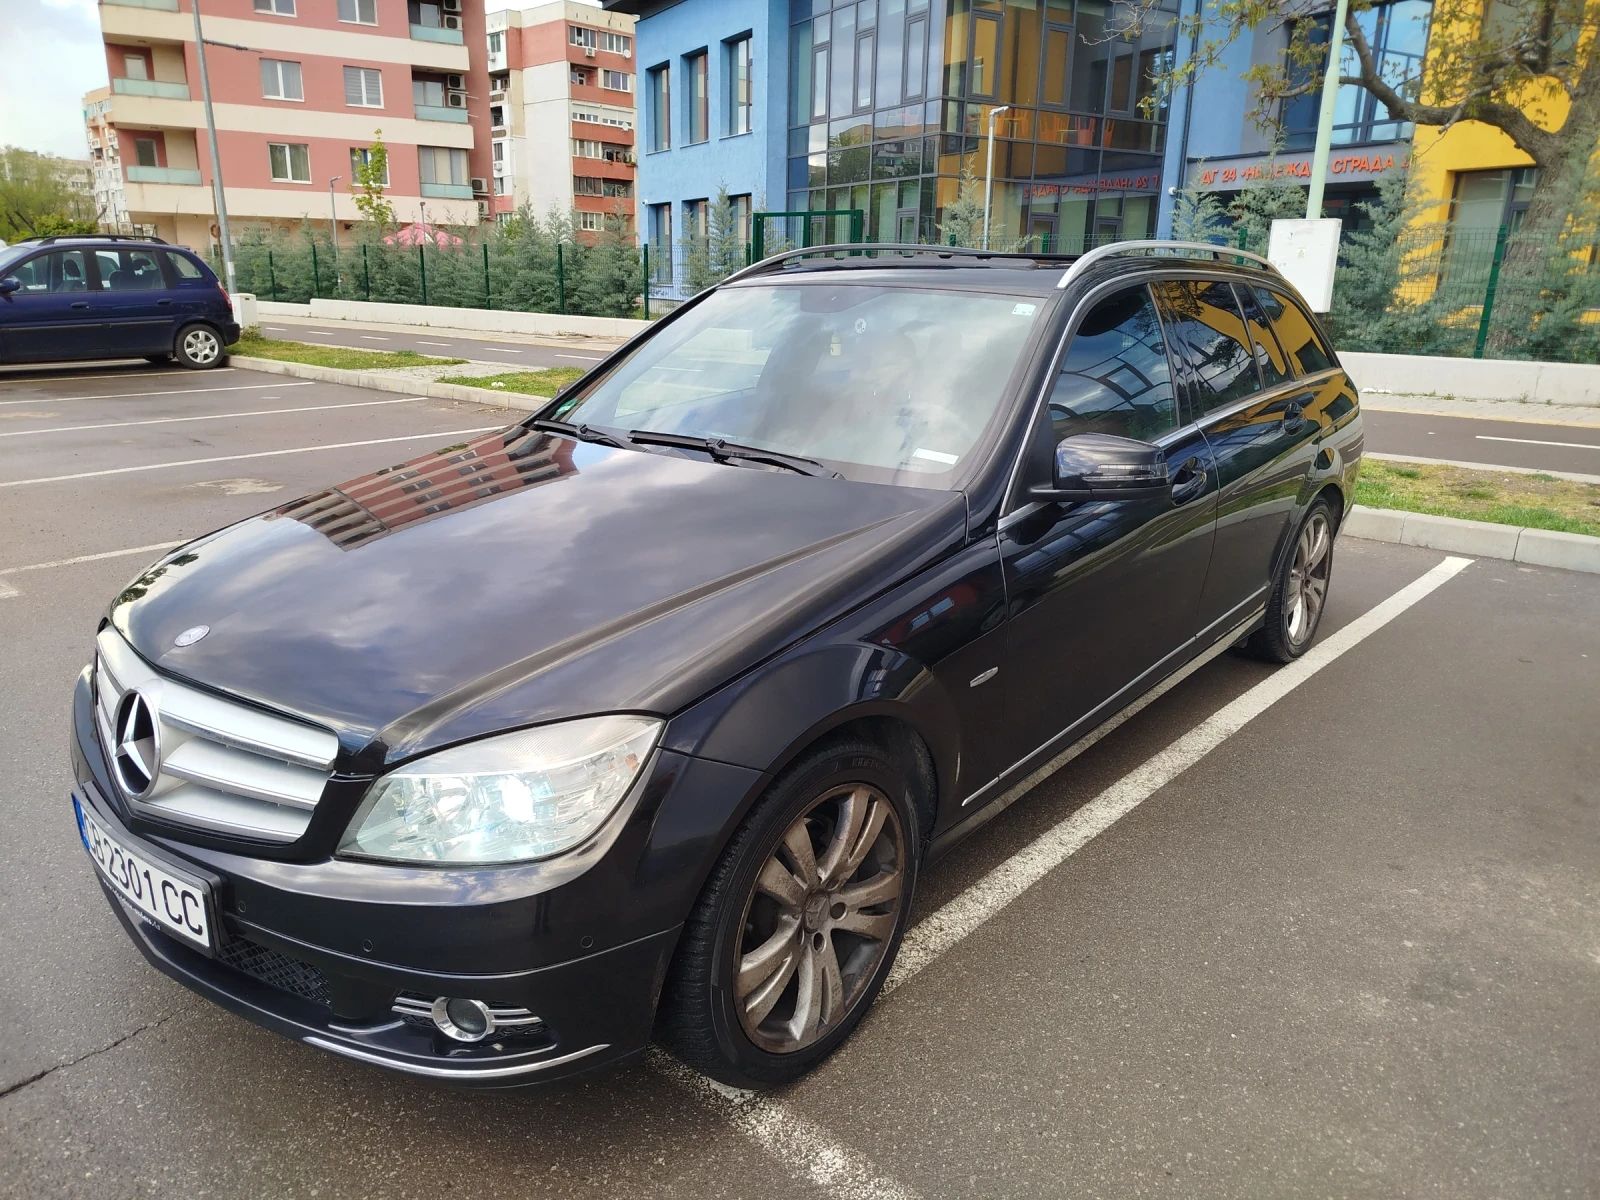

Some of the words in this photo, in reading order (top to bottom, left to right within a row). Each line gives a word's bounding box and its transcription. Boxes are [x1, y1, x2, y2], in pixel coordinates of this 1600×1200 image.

[1201, 168, 1219, 185] ДГ
[1221, 167, 1237, 183] 24
[1331, 153, 1395, 174] СГРАДА
[103, 837, 157, 911] 2301
[161, 879, 203, 936] CC
